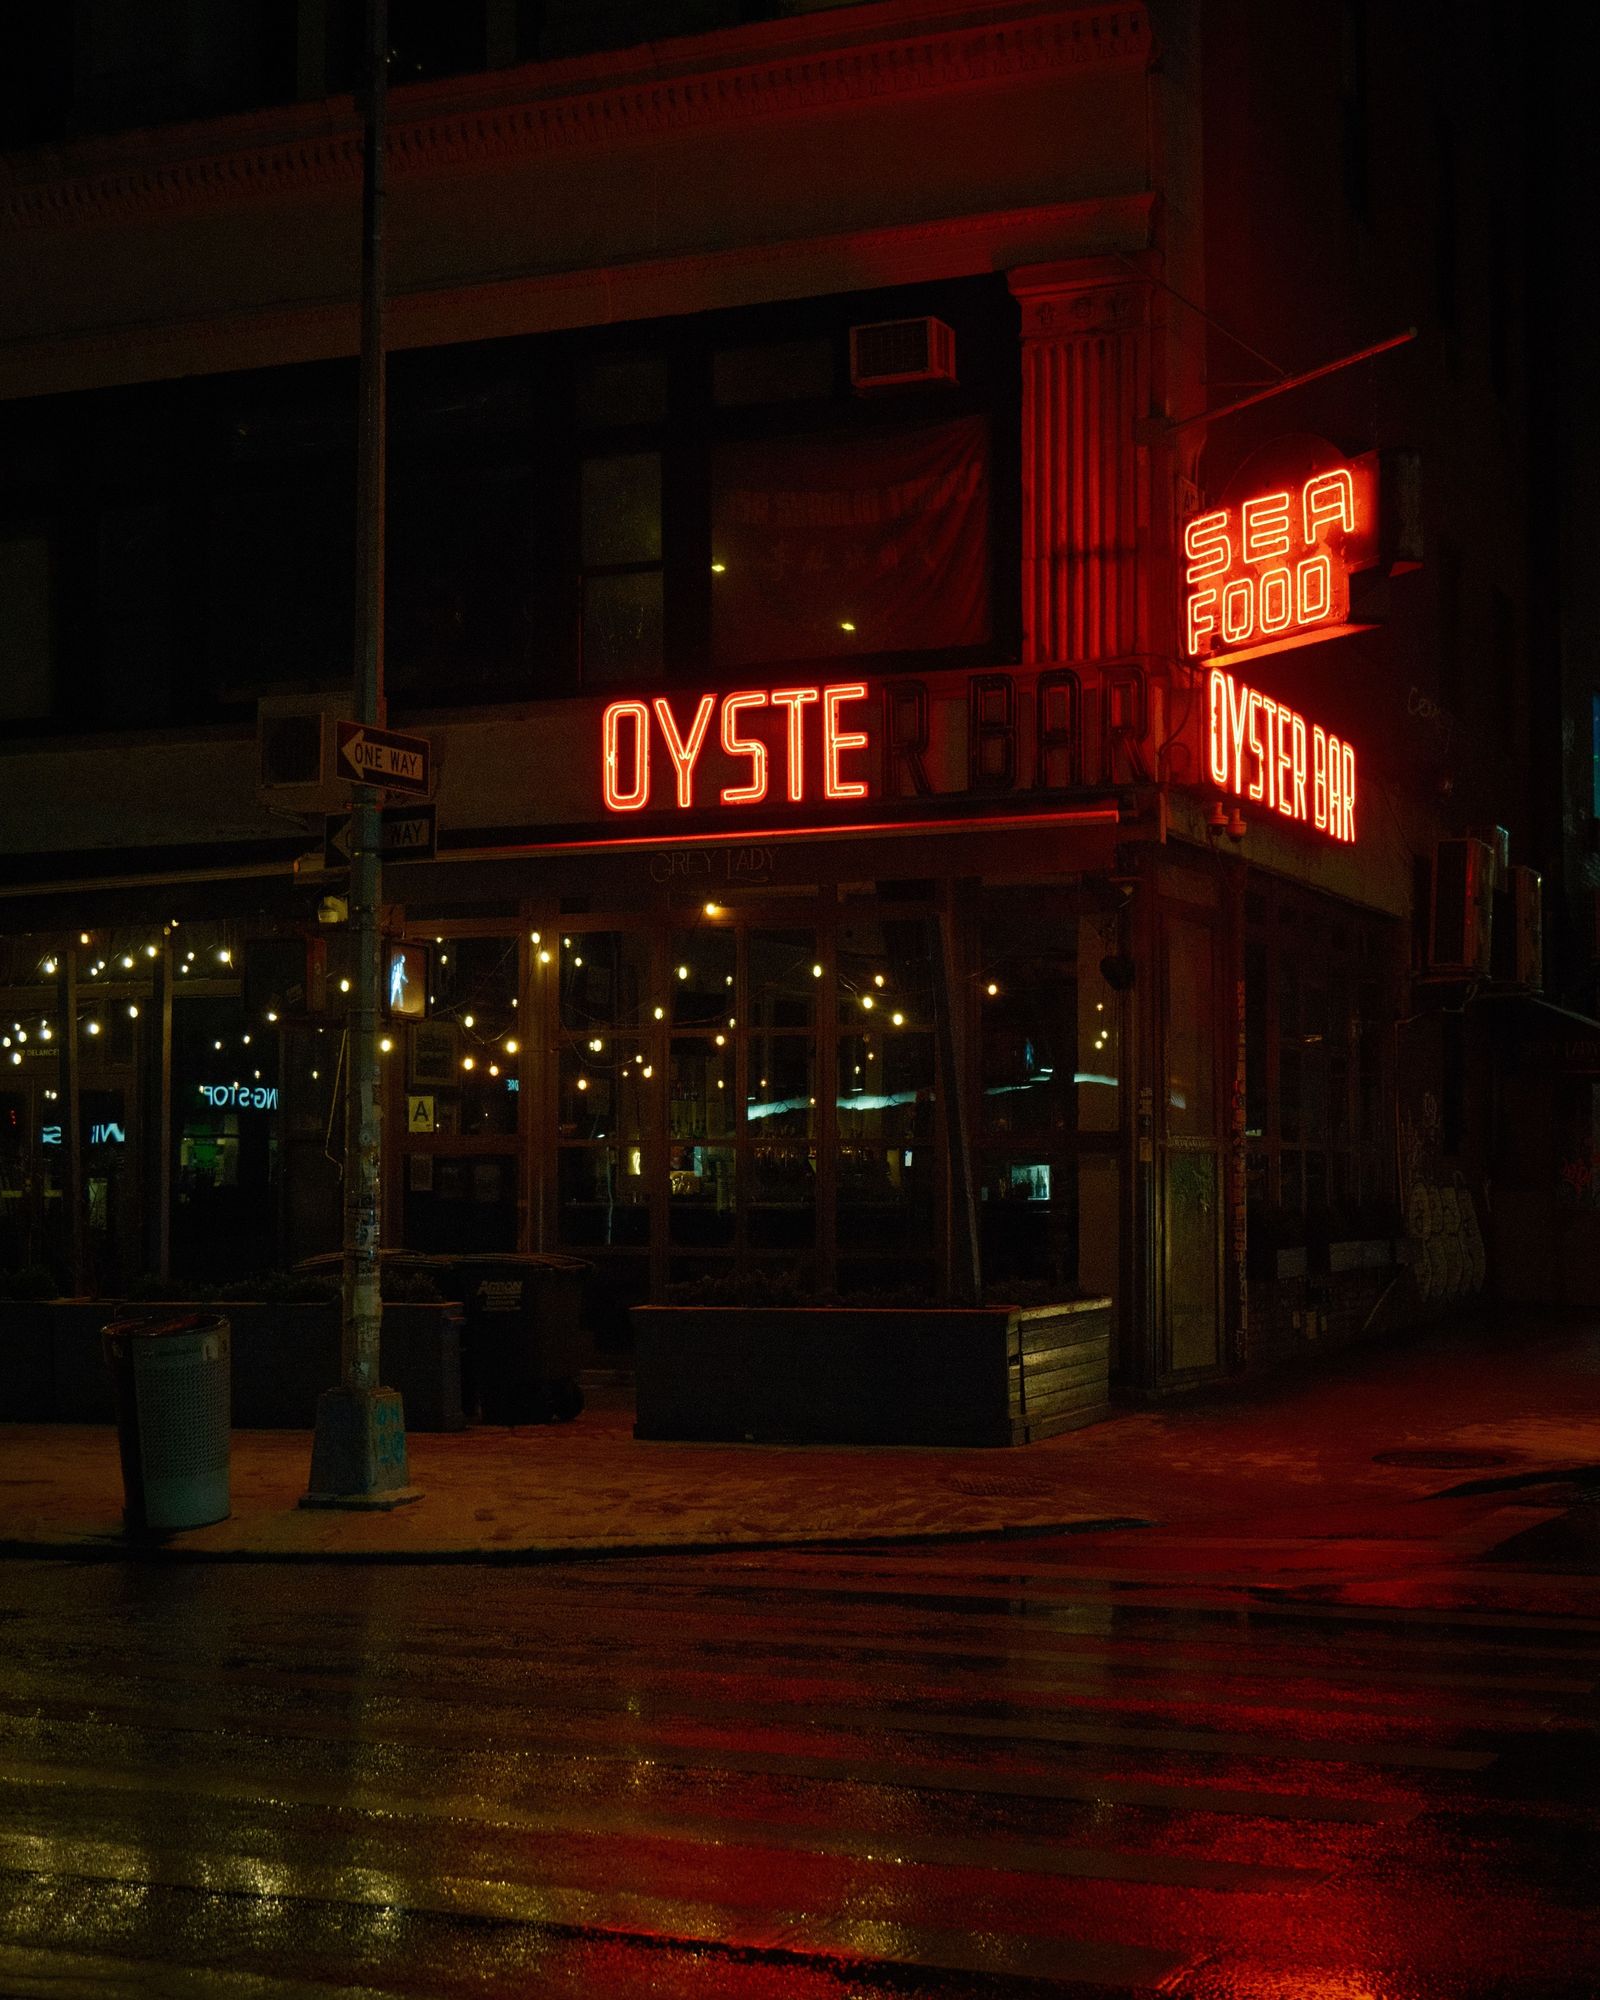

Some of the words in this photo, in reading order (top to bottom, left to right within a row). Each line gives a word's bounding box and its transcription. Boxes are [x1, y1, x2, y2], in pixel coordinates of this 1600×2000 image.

[1185, 468, 1354, 584] SEA
[1187, 555, 1330, 654] FOOD
[354, 742, 382, 768] ONE
[390, 750, 417, 776] WAY
[602, 678, 929, 812] OYSTER
[969, 667, 1154, 794] BAR
[1210, 668, 1308, 822] OYSTER
[1313, 724, 1356, 842] BAR
[389, 820, 422, 844] WAY
[650, 851, 717, 882] GREY
[727, 847, 779, 883] LADY
[412, 1101, 429, 1122] A
